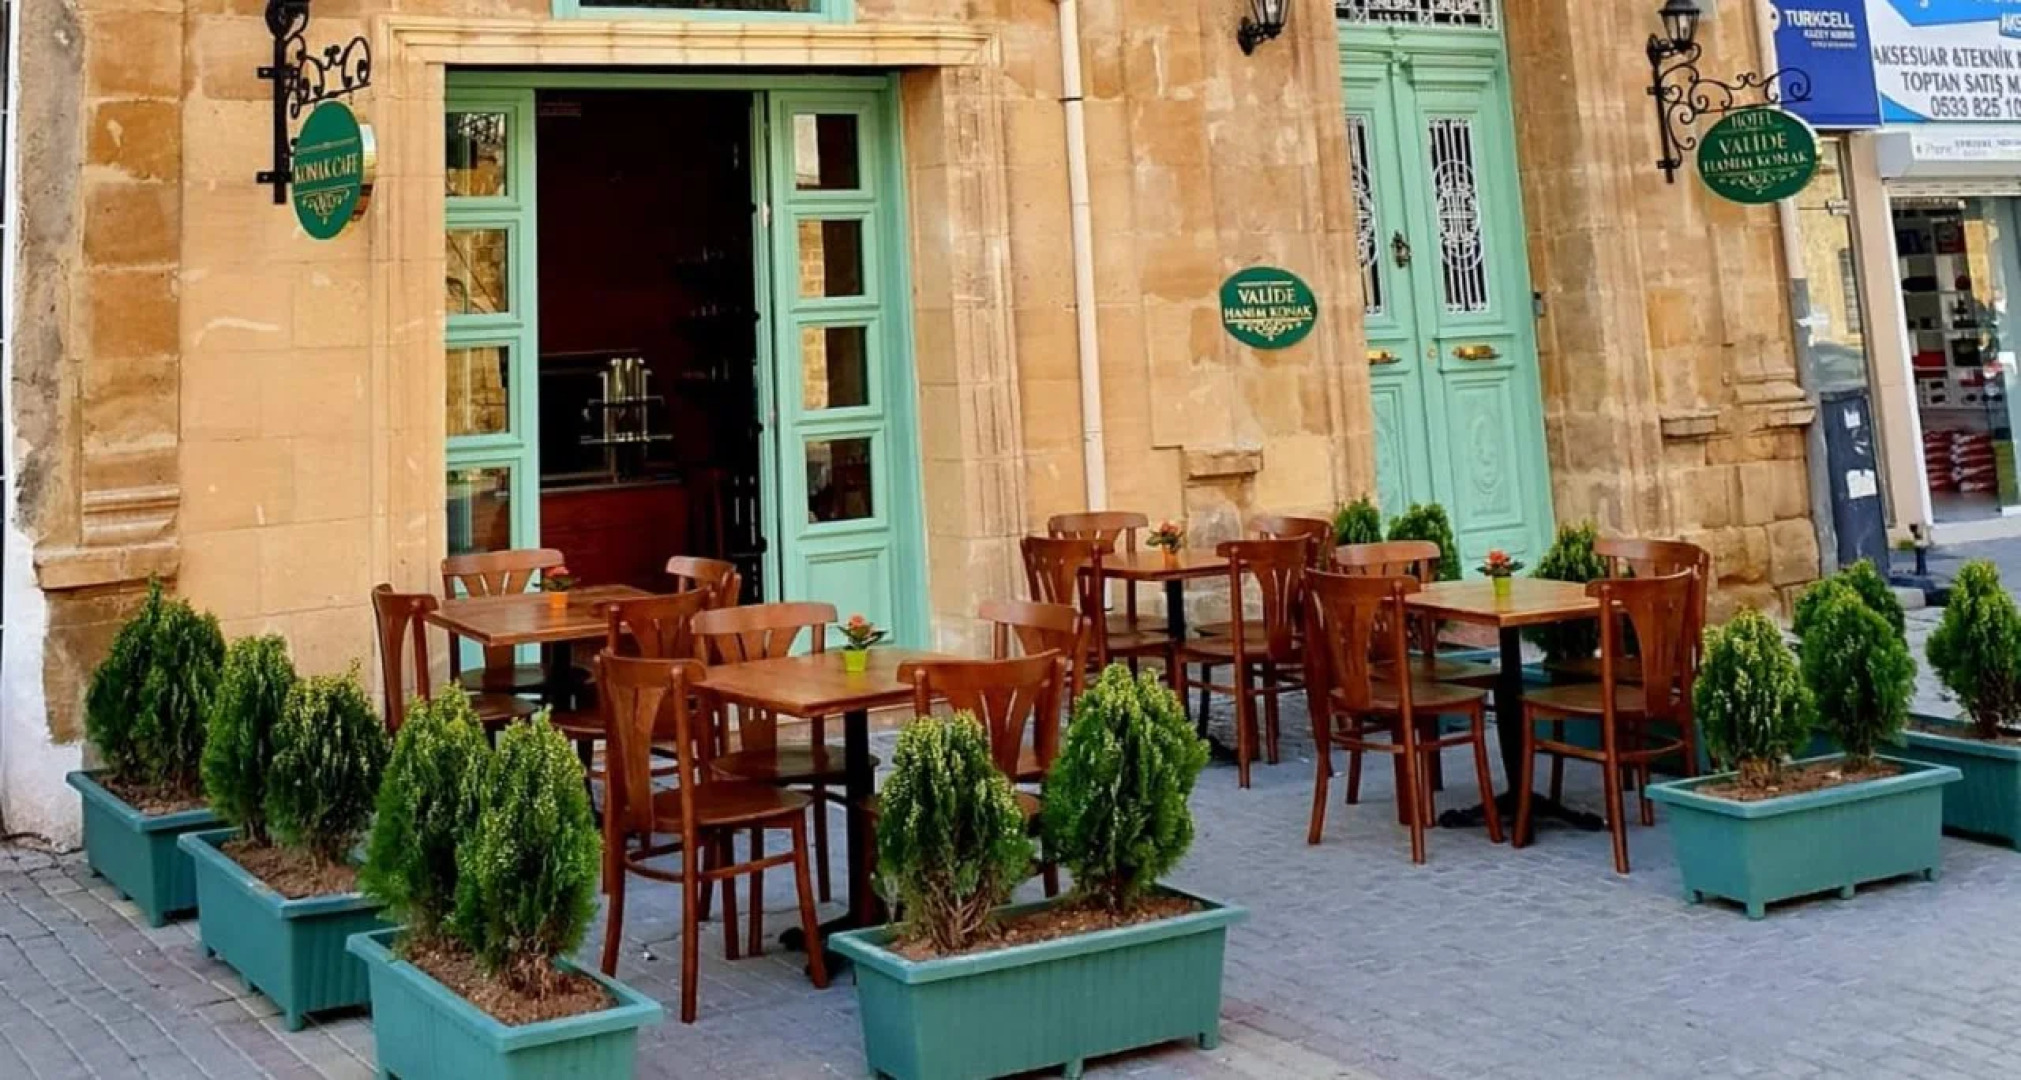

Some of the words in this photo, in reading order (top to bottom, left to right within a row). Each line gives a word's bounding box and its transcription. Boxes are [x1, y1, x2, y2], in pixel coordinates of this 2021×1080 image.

[1784, 9, 1855, 28] TURKCELL
[1874, 45, 1948, 66] AKSESUAR
[1901, 71, 1962, 93] TOPTAN
[1964, 73, 2003, 99] SATIŞ
[1930, 95, 1969, 117] 0533
[1973, 97, 2001, 118] 825
[1731, 111, 1773, 129] HOTEL
[1719, 132, 1788, 155] VALİDE
[294, 160, 331, 184] KONAK
[332, 153, 358, 178] CAFE
[1703, 157, 1754, 173] HANIM
[1756, 151, 1809, 168] KONAK
[1269, 304, 1312, 318] KONAK
